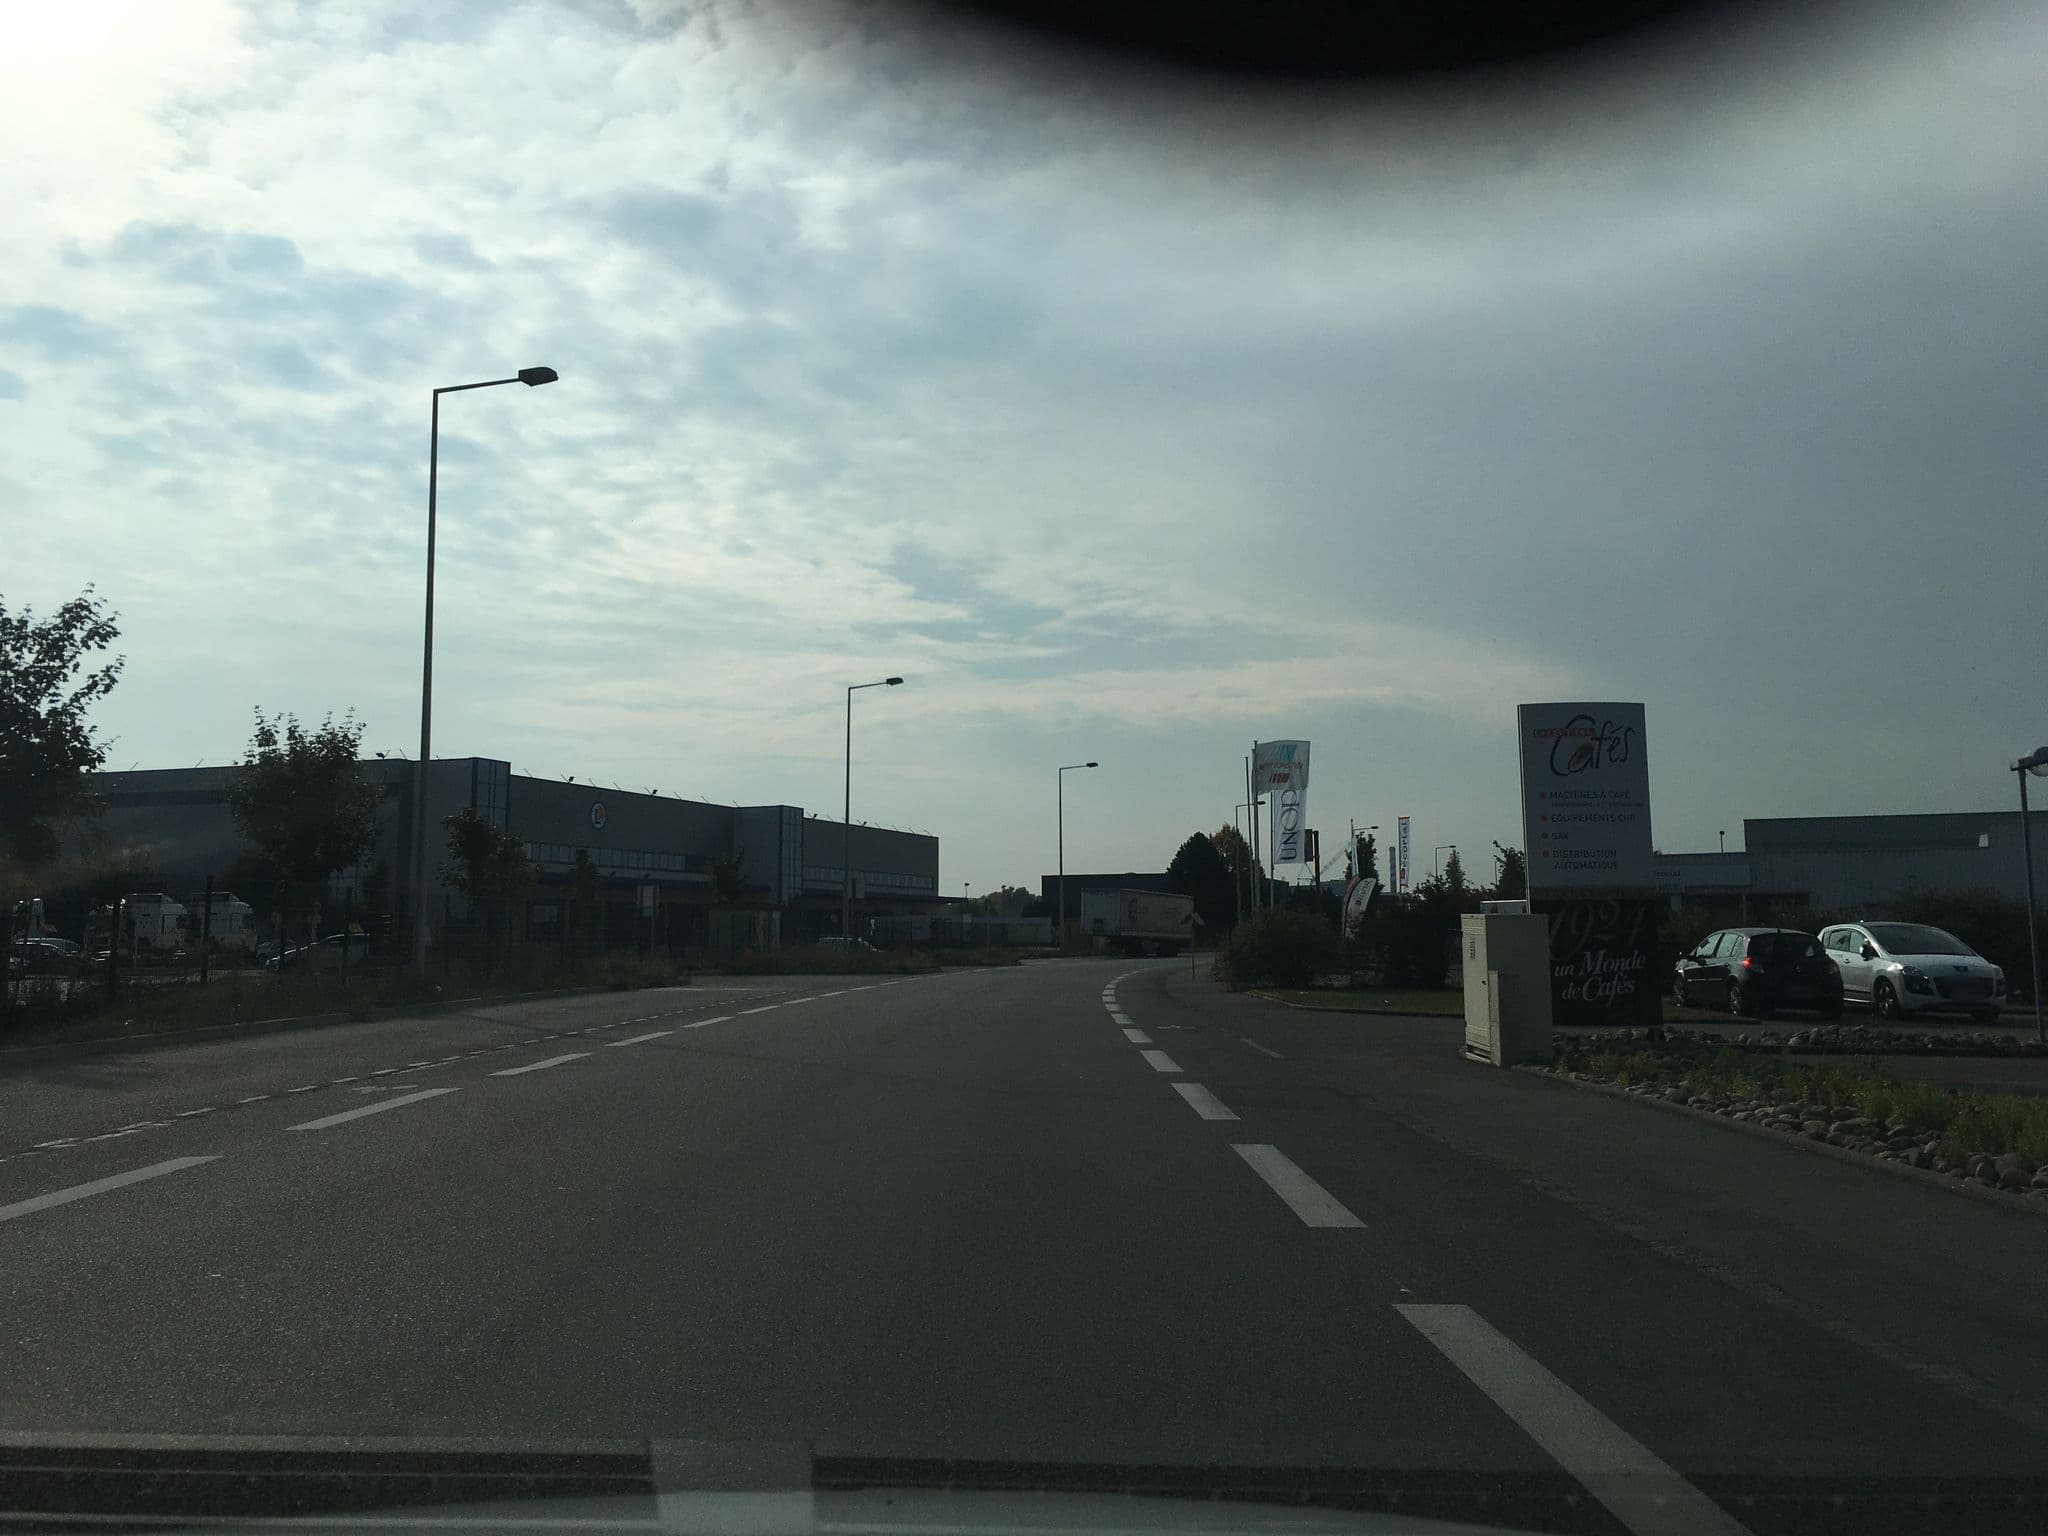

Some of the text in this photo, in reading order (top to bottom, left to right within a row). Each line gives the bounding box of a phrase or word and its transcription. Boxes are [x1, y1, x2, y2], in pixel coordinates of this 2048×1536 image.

[1552, 850, 1617, 859] DISTRIBUTION
[1554, 861, 1618, 871] AUTOMATIQUE
[1554, 949, 1647, 977] un Monde
[1561, 971, 1636, 1008] de Cafés
